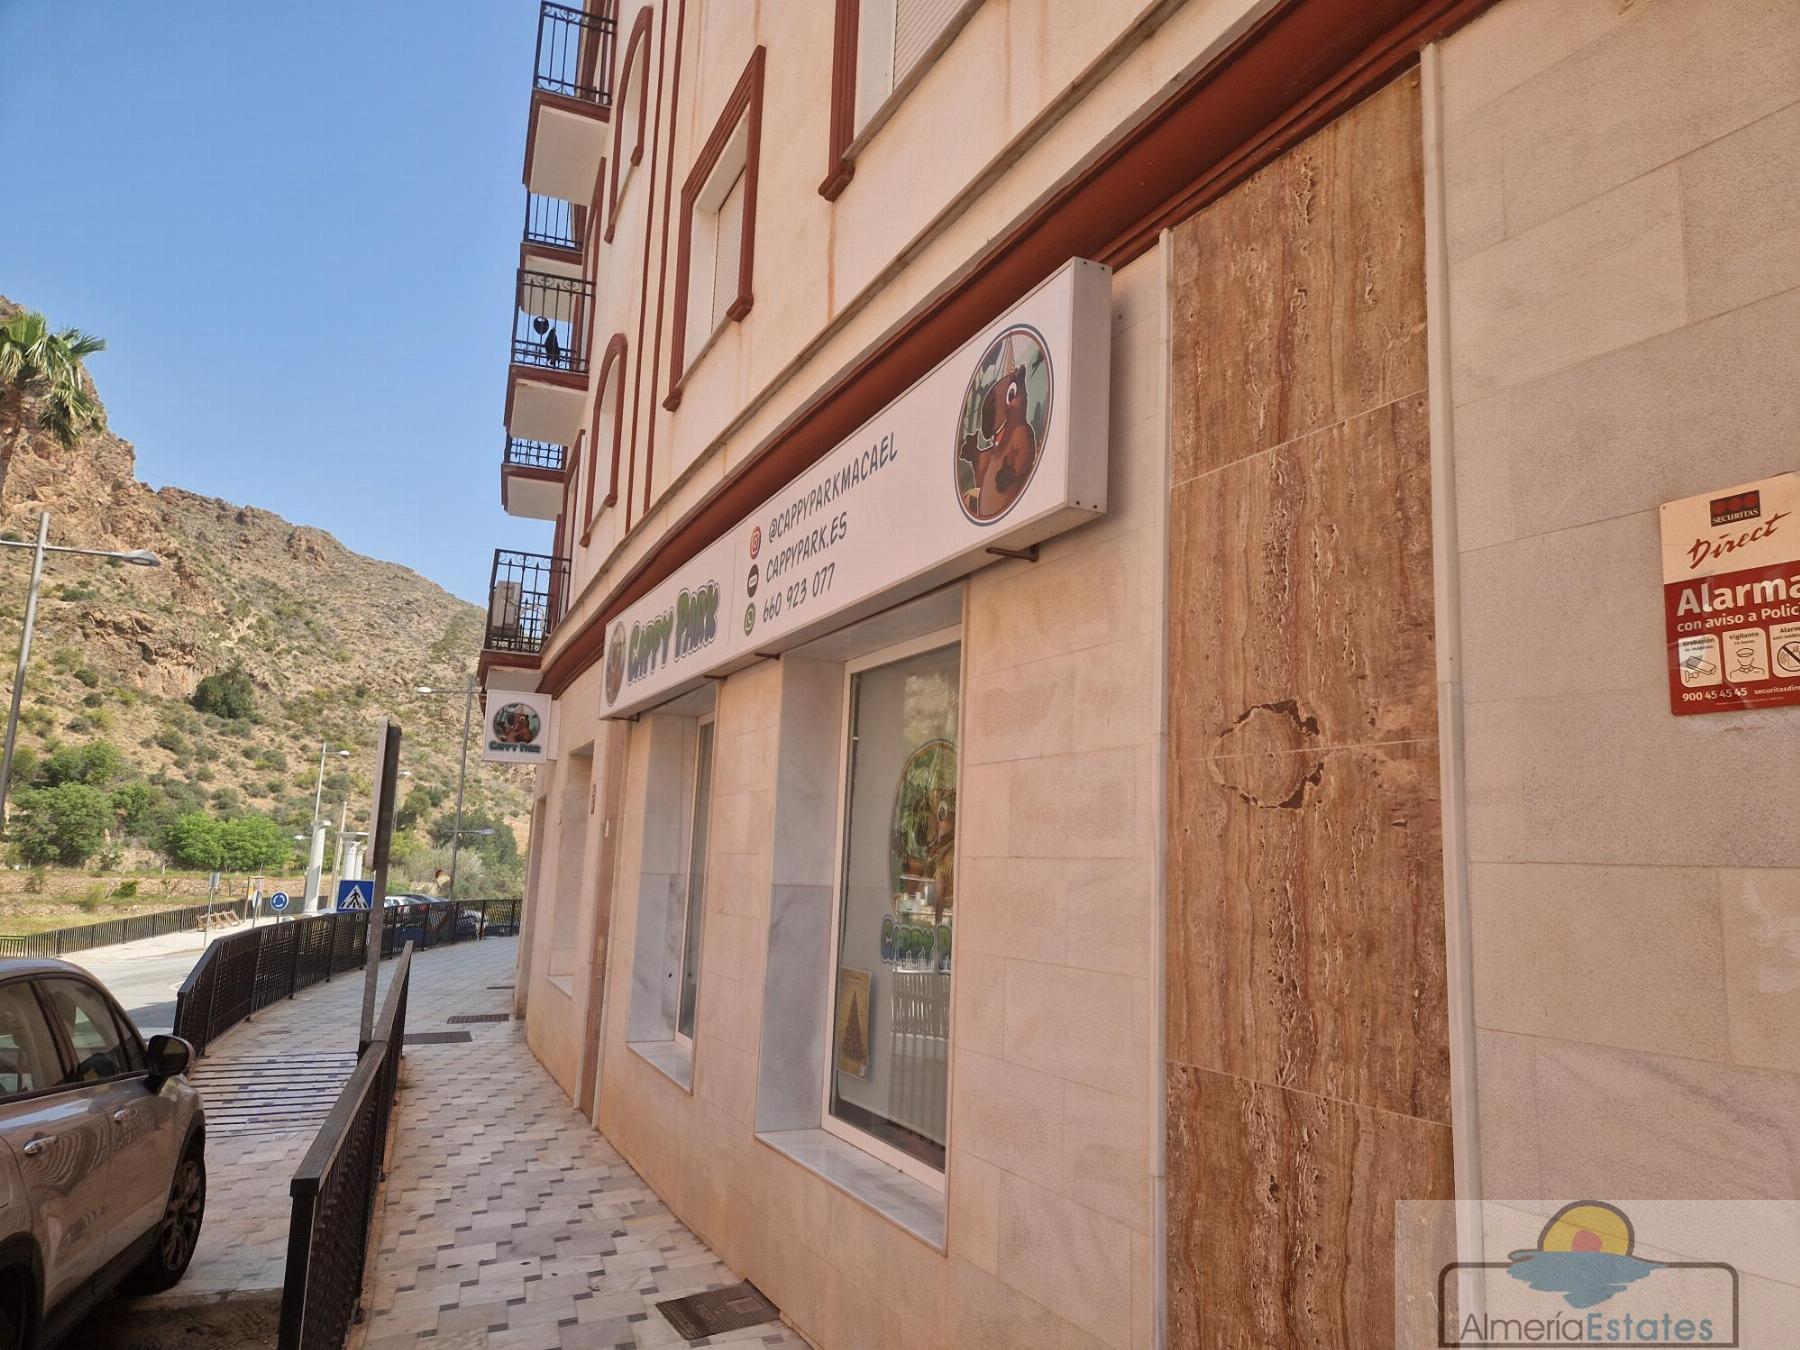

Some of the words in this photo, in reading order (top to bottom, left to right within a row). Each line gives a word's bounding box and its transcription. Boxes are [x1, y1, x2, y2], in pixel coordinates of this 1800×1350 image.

[768, 432, 898, 543] @CAPPYPARKMACAEL
[1712, 508, 1759, 523] SECURITAS
[766, 511, 847, 583] CAPPYPARK.ES
[1686, 511, 1792, 570] Direct
[763, 592, 782, 622] 660
[786, 578, 807, 611] 923
[812, 562, 835, 598] 077
[1677, 621, 1702, 632] con
[1705, 613, 1744, 628] aviso
[1747, 612, 1758, 622] a
[1761, 604, 1800, 620] Polic
[1682, 692, 1703, 702] 900
[1704, 689, 1718, 699] 45
[1719, 688, 1732, 698] 45
[1734, 686, 1748, 697] 45
